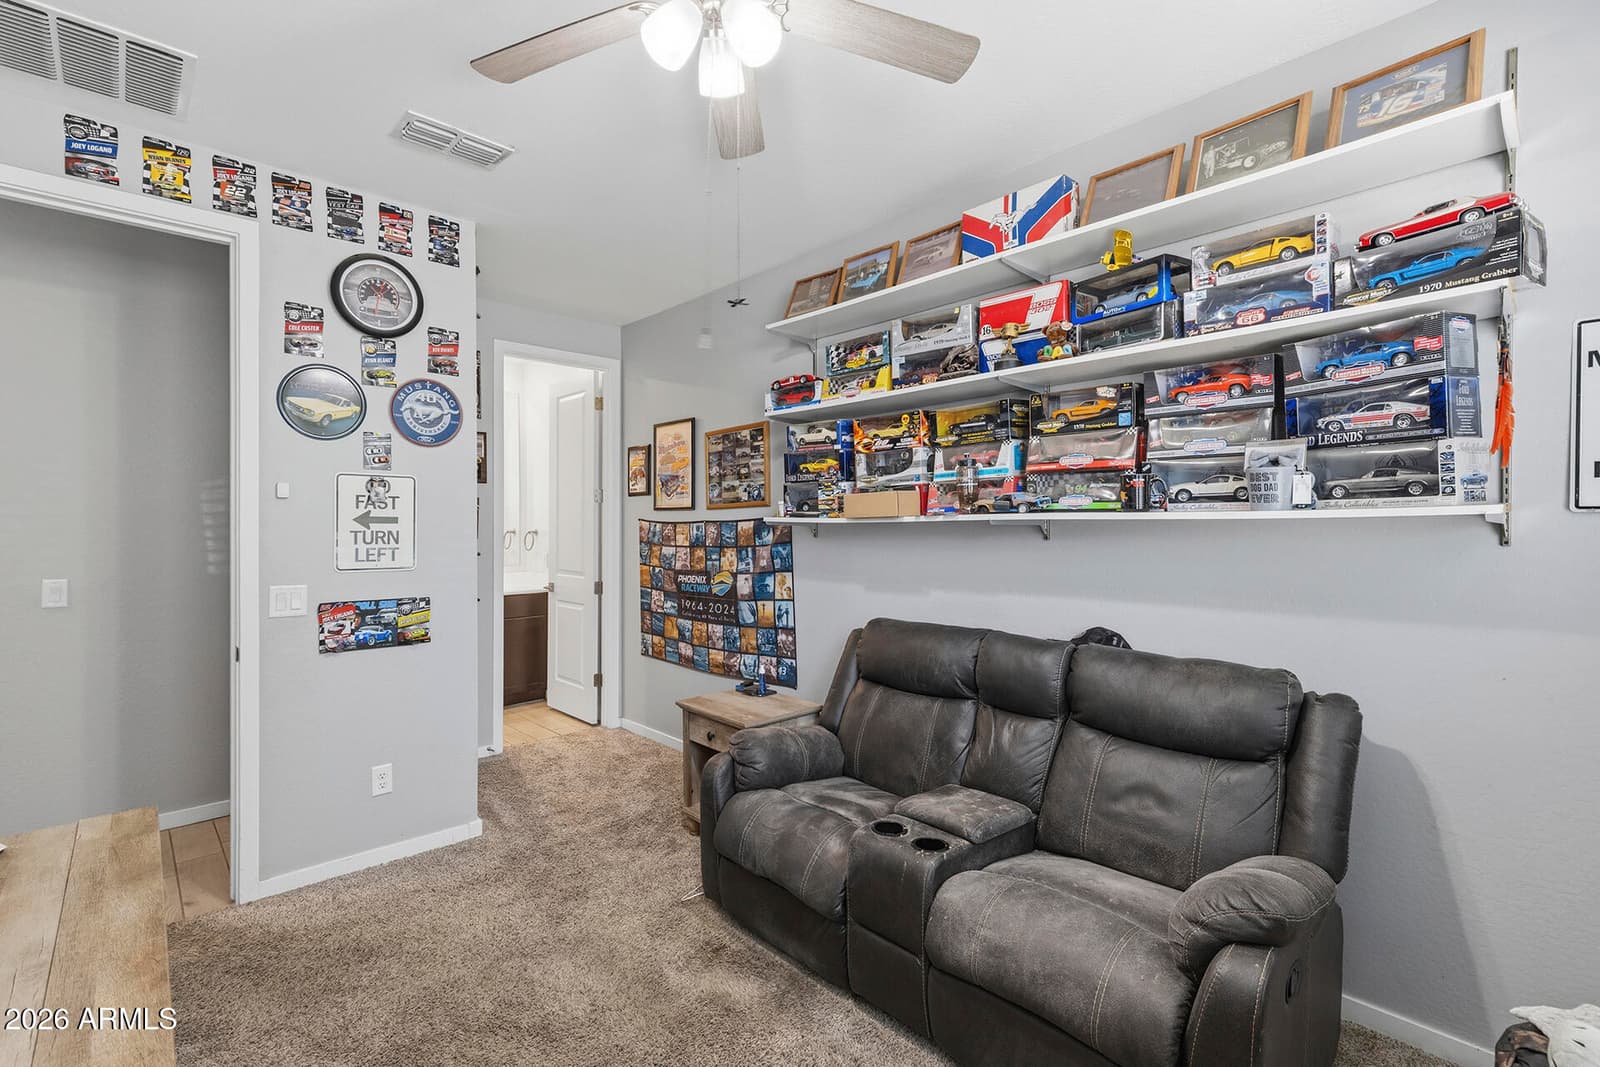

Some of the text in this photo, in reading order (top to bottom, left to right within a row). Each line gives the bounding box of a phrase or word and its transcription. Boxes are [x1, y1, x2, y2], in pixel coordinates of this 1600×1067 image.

[71, 142, 113, 154] JOEY LOGANO
[224, 184, 246, 197] 22
[1418, 267, 1519, 293] 1970 Mustang Grabber
[1241, 314, 1259, 323] 66
[982, 325, 991, 336] 16
[397, 381, 456, 408] MUSTANG
[1318, 430, 1364, 446] LEGENDS
[1249, 471, 1279, 482] BEST
[1263, 482, 1279, 492] DAD
[355, 494, 400, 510] FAST
[1250, 494, 1280, 504] EVER
[349, 530, 400, 545] TURN
[354, 547, 399, 563] LEFT
[677, 574, 707, 584] PHOENIX
[681, 583, 711, 593] RACEWAY
